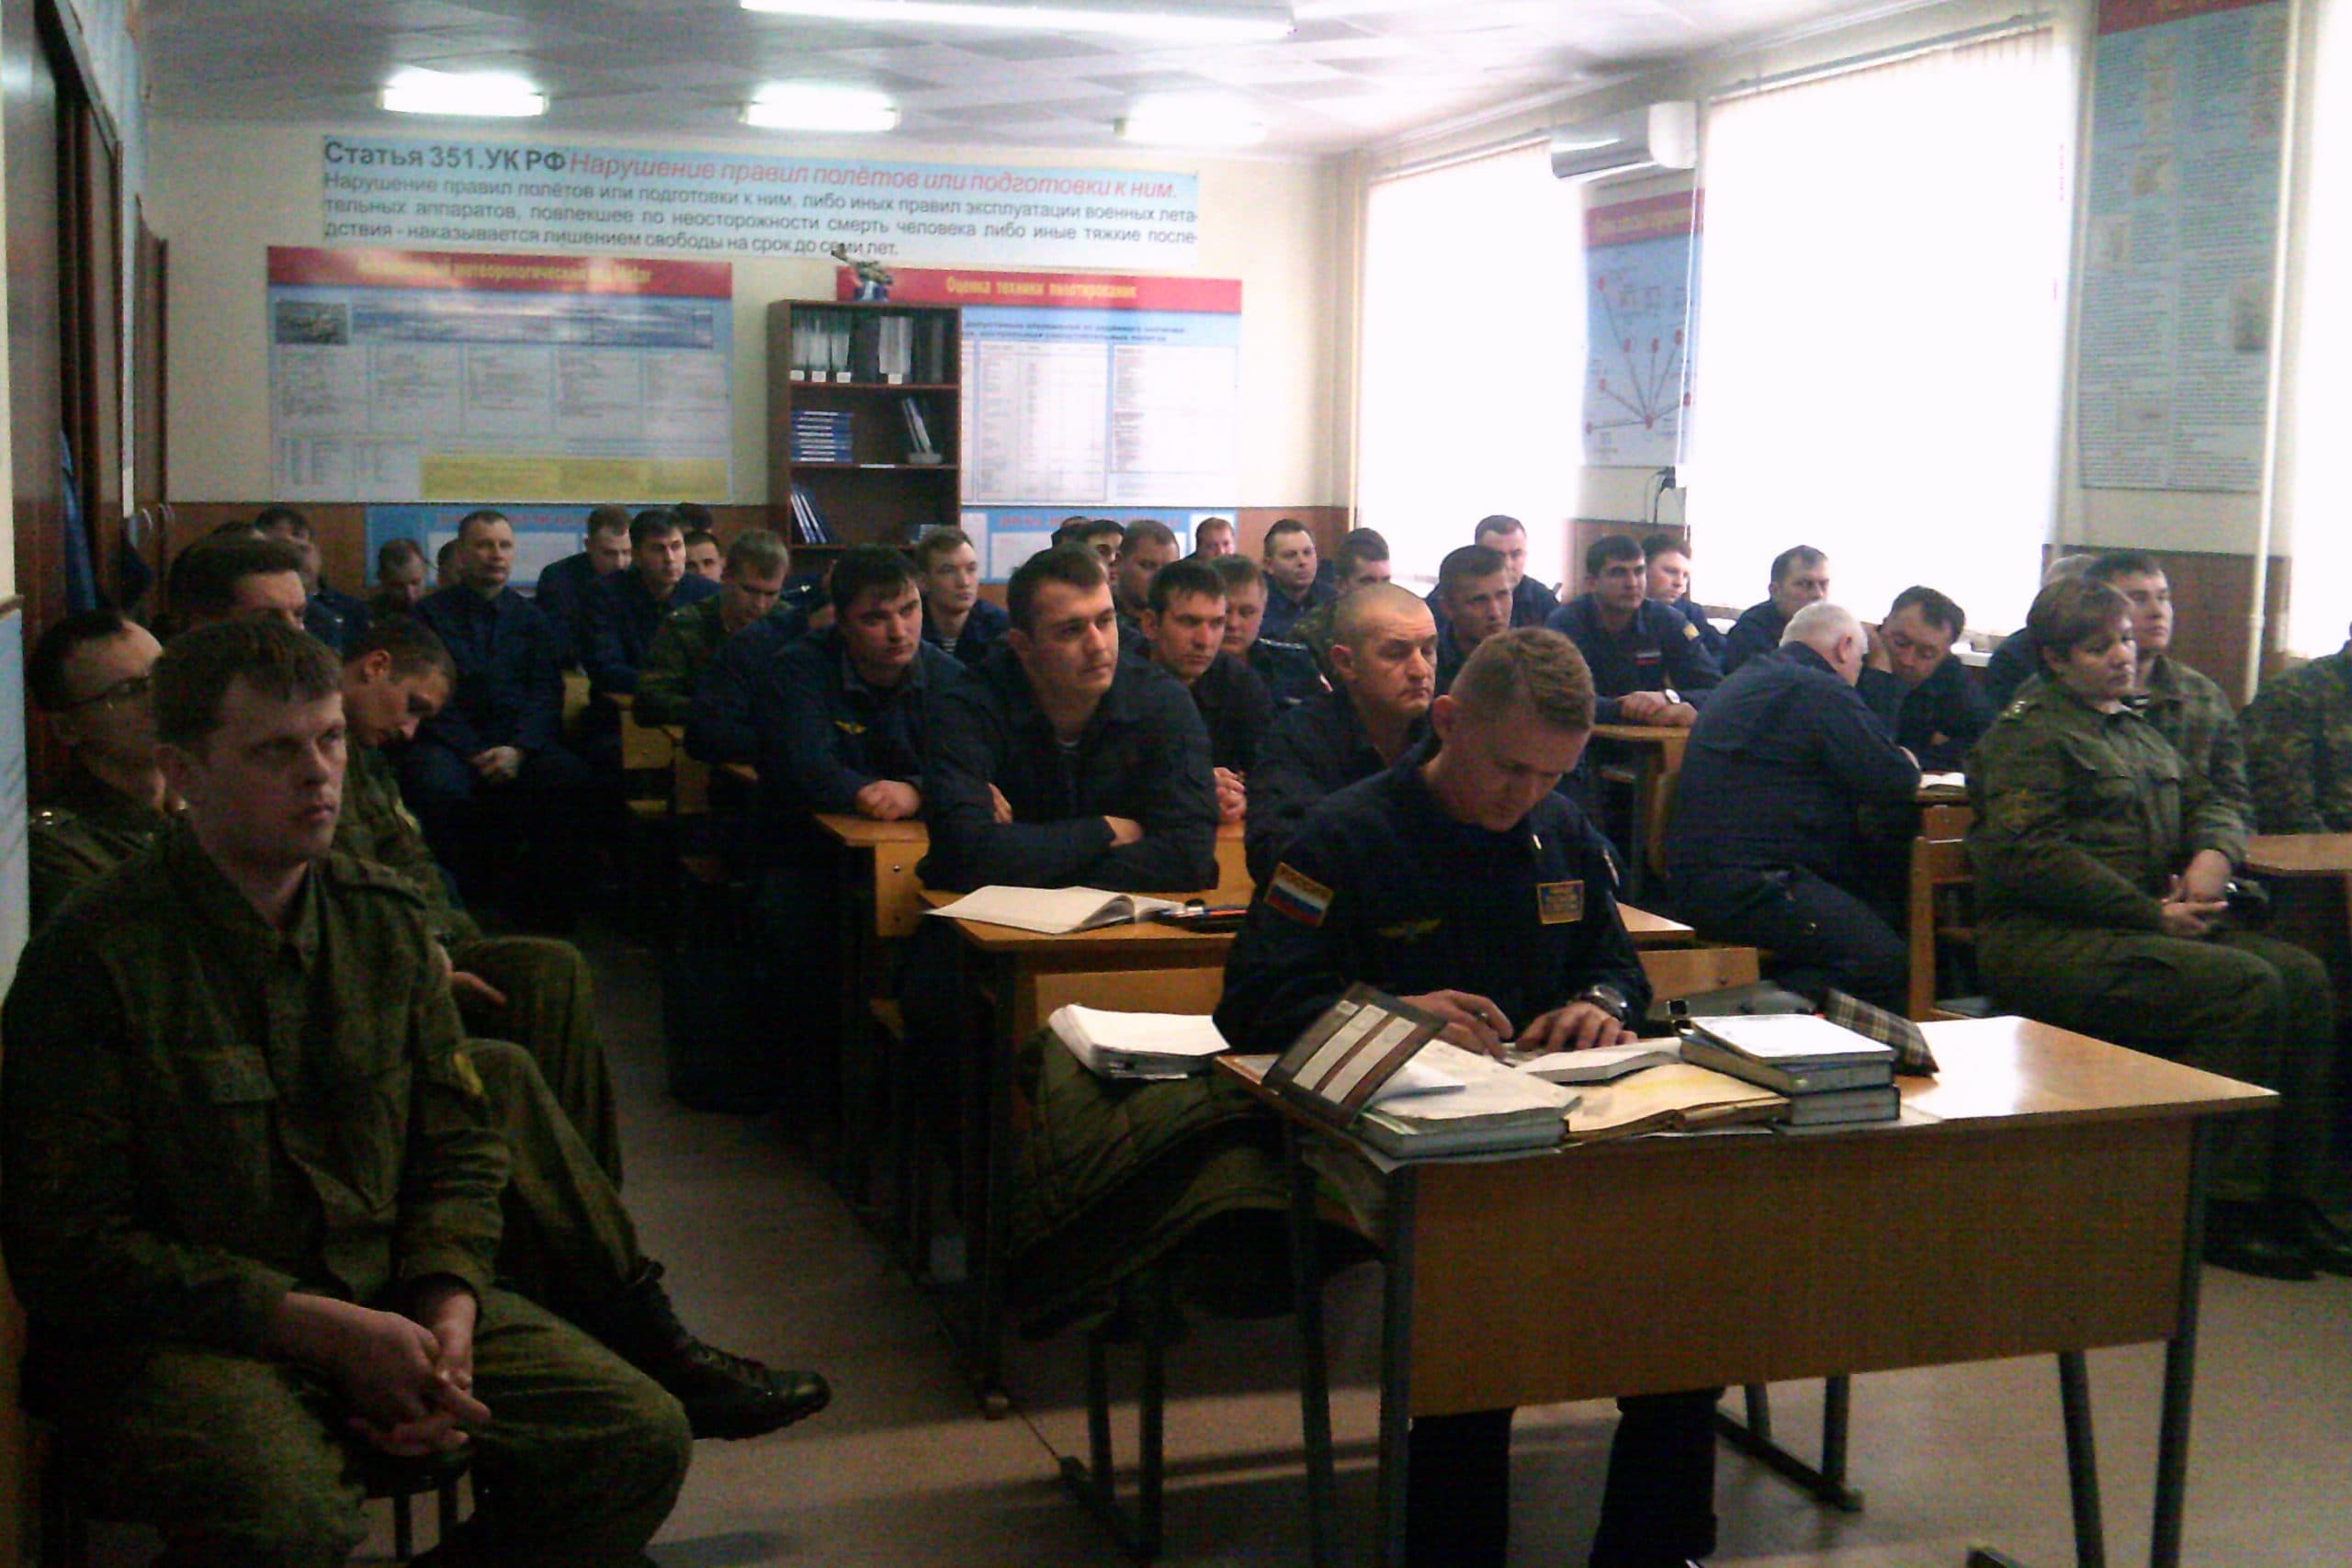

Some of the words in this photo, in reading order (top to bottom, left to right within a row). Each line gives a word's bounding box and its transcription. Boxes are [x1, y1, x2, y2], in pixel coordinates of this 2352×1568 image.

[324, 141, 423, 167] Статья
[526, 150, 566, 172] РФ
[569, 152, 716, 181] Нарушение
[719, 164, 809, 185] правил
[923, 174, 967, 189] или
[969, 172, 1110, 196] подготовки
[1114, 181, 1127, 197] к
[323, 172, 437, 194] Нарушение
[443, 179, 513, 197] правил
[599, 185, 634, 200] или
[639, 188, 738, 205] подготовки
[802, 192, 847, 209] либо
[850, 197, 895, 211] иных
[899, 199, 961, 215] правил
[965, 201, 1081, 220] эксплуатации
[1085, 205, 1155, 220] военных
[407, 228, 539, 244] наказывается
[543, 229, 642, 246] лишением
[645, 231, 724, 252] свободы
[727, 238, 749, 251] на
[751, 236, 793, 254] срок
[794, 238, 818, 254] до
[530, 205, 634, 223] повлекшее
[641, 209, 664, 225] по
[672, 212, 820, 231] неосторожности
[826, 217, 890, 235] смерть
[895, 220, 977, 237] человека
[983, 221, 1026, 238] либо
[1033, 226, 1077, 240] иные
[1084, 227, 1141, 243] тяжкие
